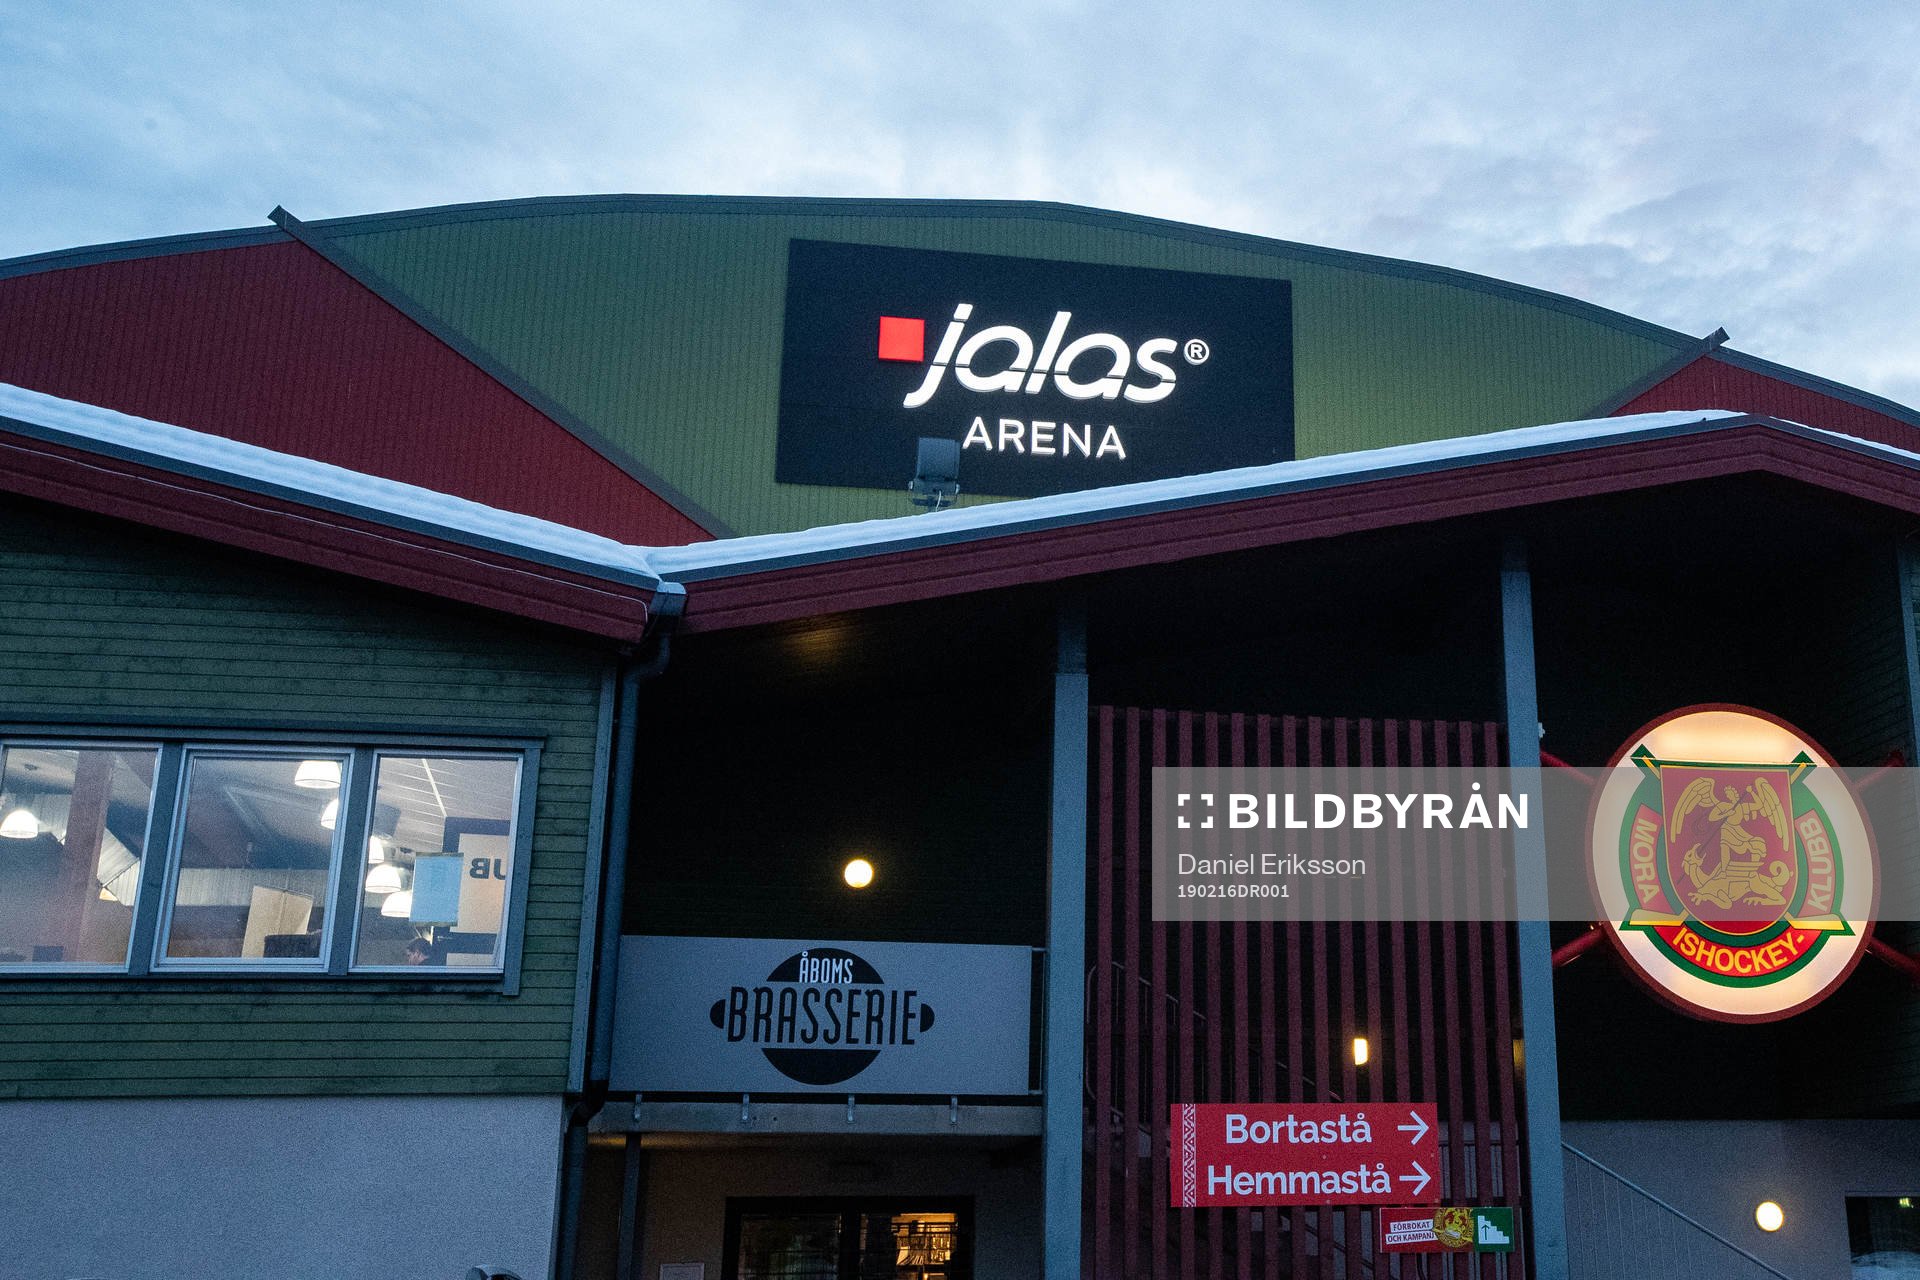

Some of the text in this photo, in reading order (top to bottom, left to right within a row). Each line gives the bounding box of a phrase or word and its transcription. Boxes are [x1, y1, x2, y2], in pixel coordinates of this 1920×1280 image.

[962, 415, 1127, 461] ARENA
[1632, 818, 1660, 903] MORA
[1799, 817, 1833, 912] KLUBB
[799, 951, 854, 984] ÅBOMS
[727, 986, 918, 1045] BRASSERIE
[1225, 1112, 1372, 1144] Bortastå
[1208, 1163, 1392, 1196] Hemmastå
[1387, 1234, 1402, 1243] OCH
